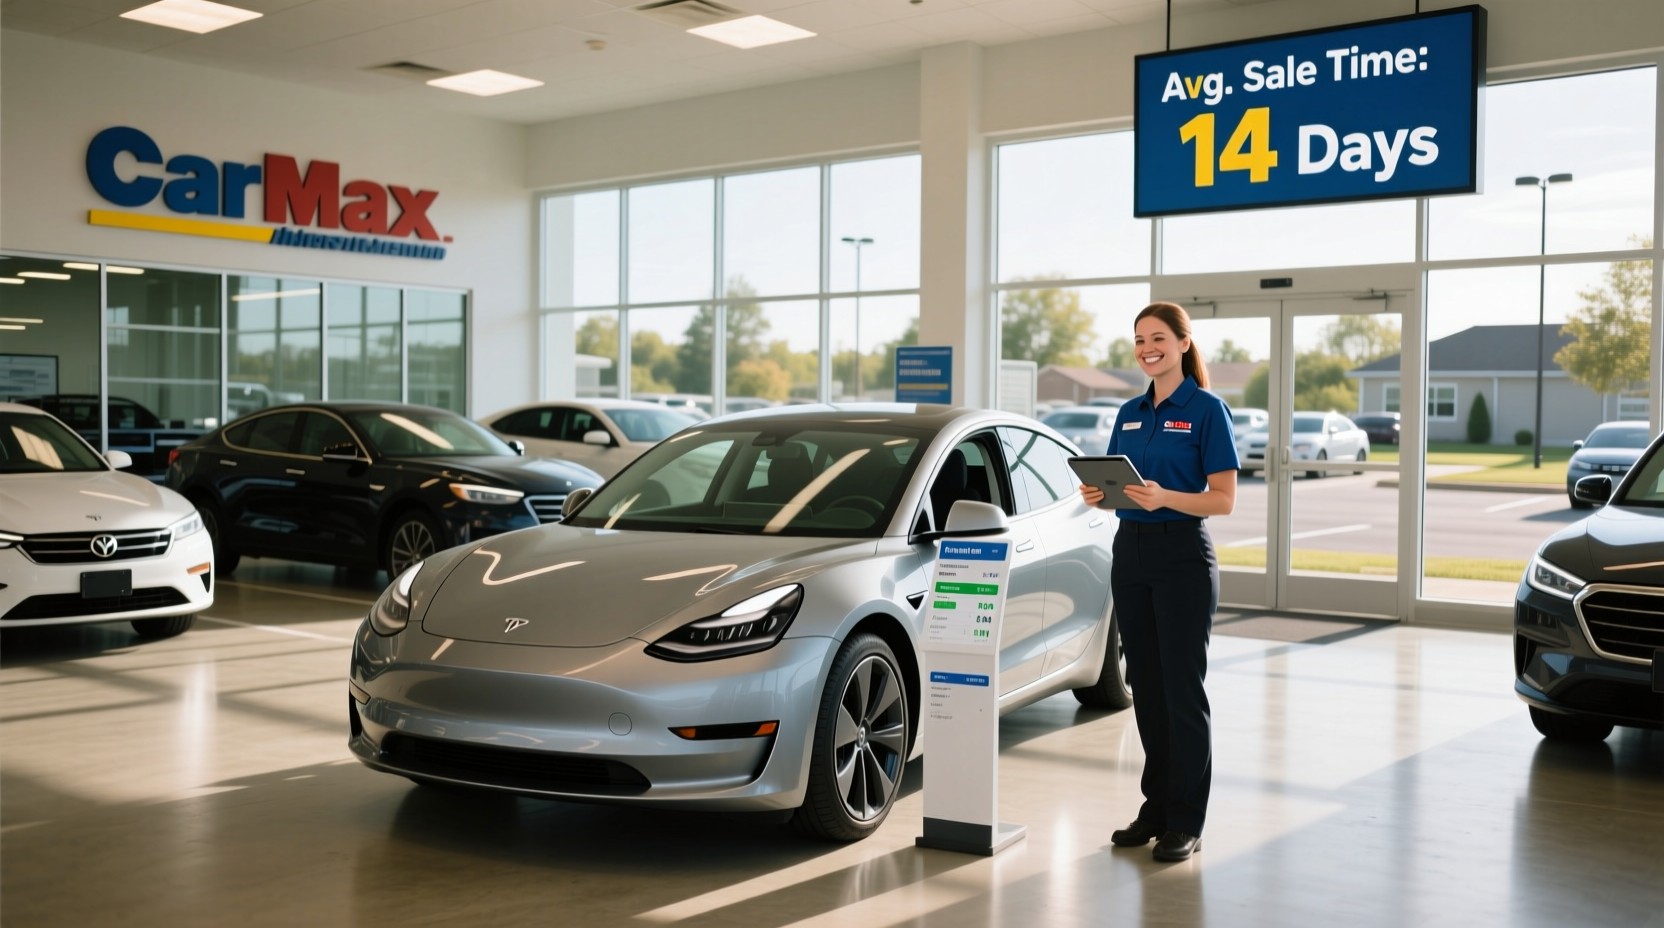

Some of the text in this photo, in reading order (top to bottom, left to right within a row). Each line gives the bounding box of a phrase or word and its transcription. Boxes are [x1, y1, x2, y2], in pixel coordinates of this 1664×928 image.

[1161, 46, 1428, 105] Avg. Sale Time:
[1179, 107, 1439, 187] 14 Days
